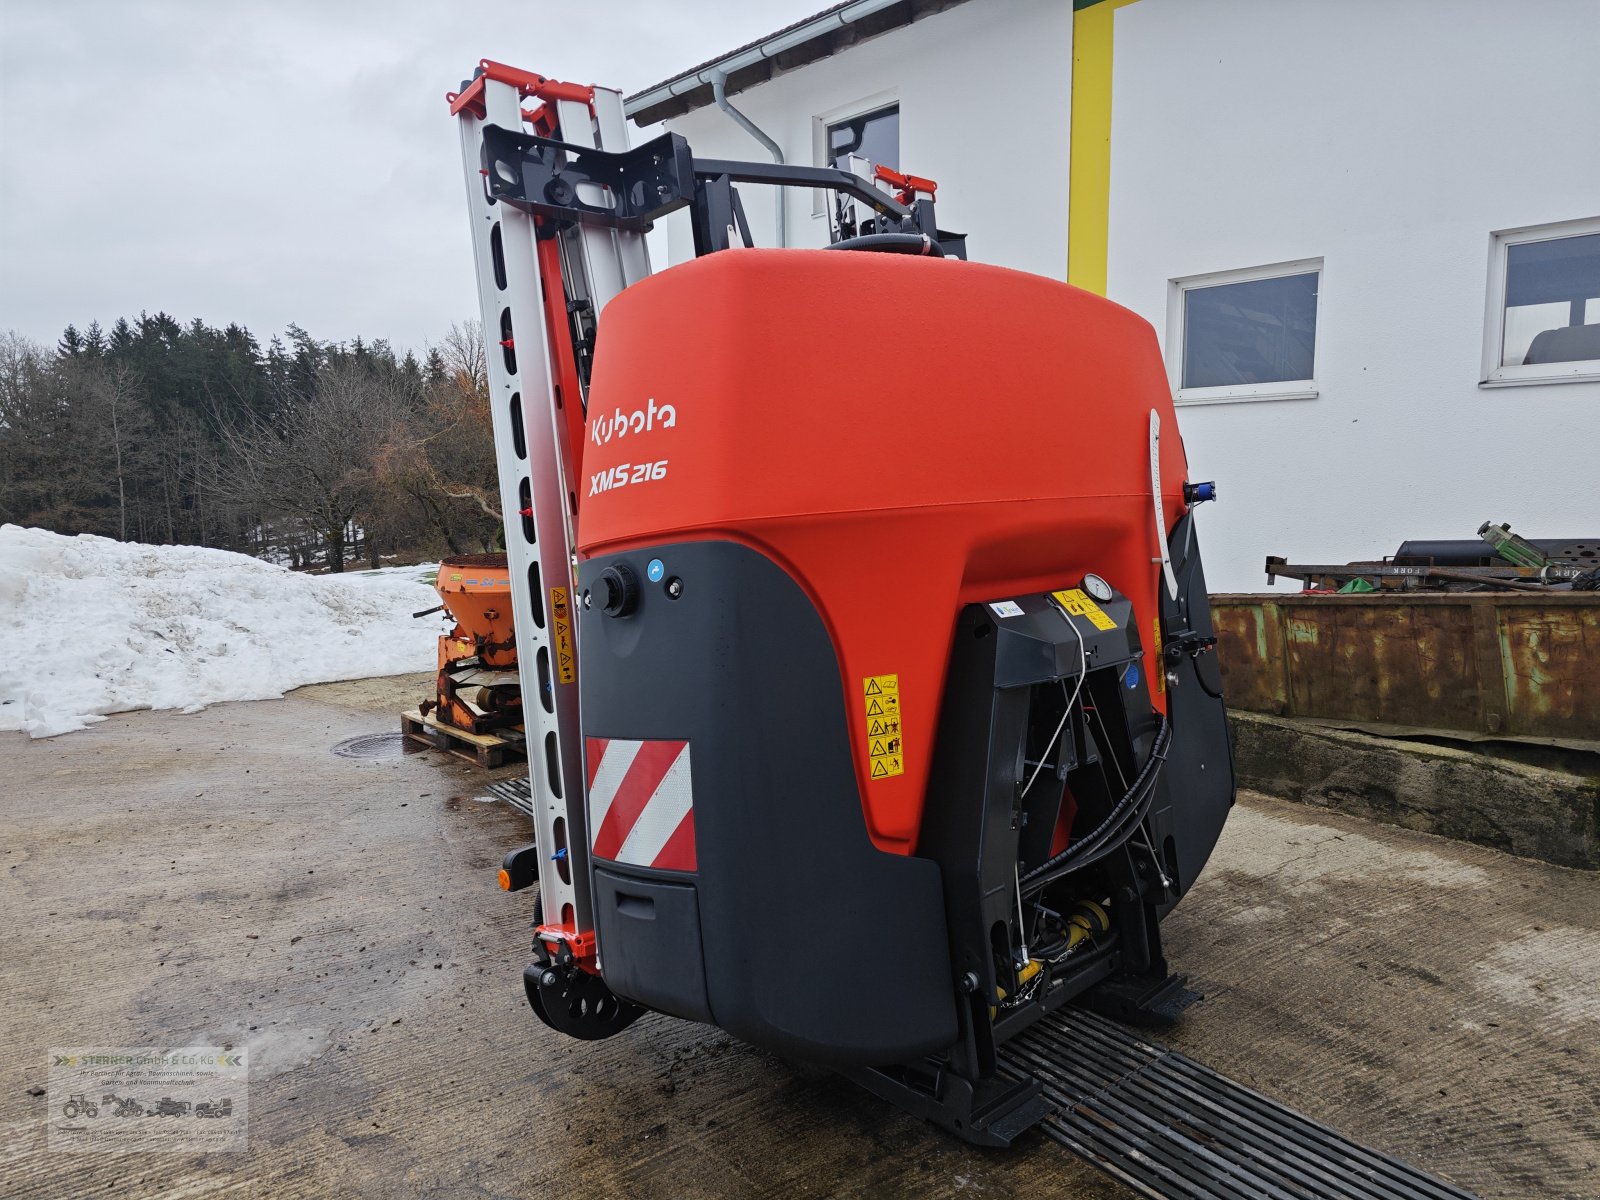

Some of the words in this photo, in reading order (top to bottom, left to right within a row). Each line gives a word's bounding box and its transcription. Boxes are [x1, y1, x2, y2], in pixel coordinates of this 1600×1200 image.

[591, 398, 676, 446] Kubota
[588, 463, 631, 497] XMS
[630, 460, 669, 485] 216
